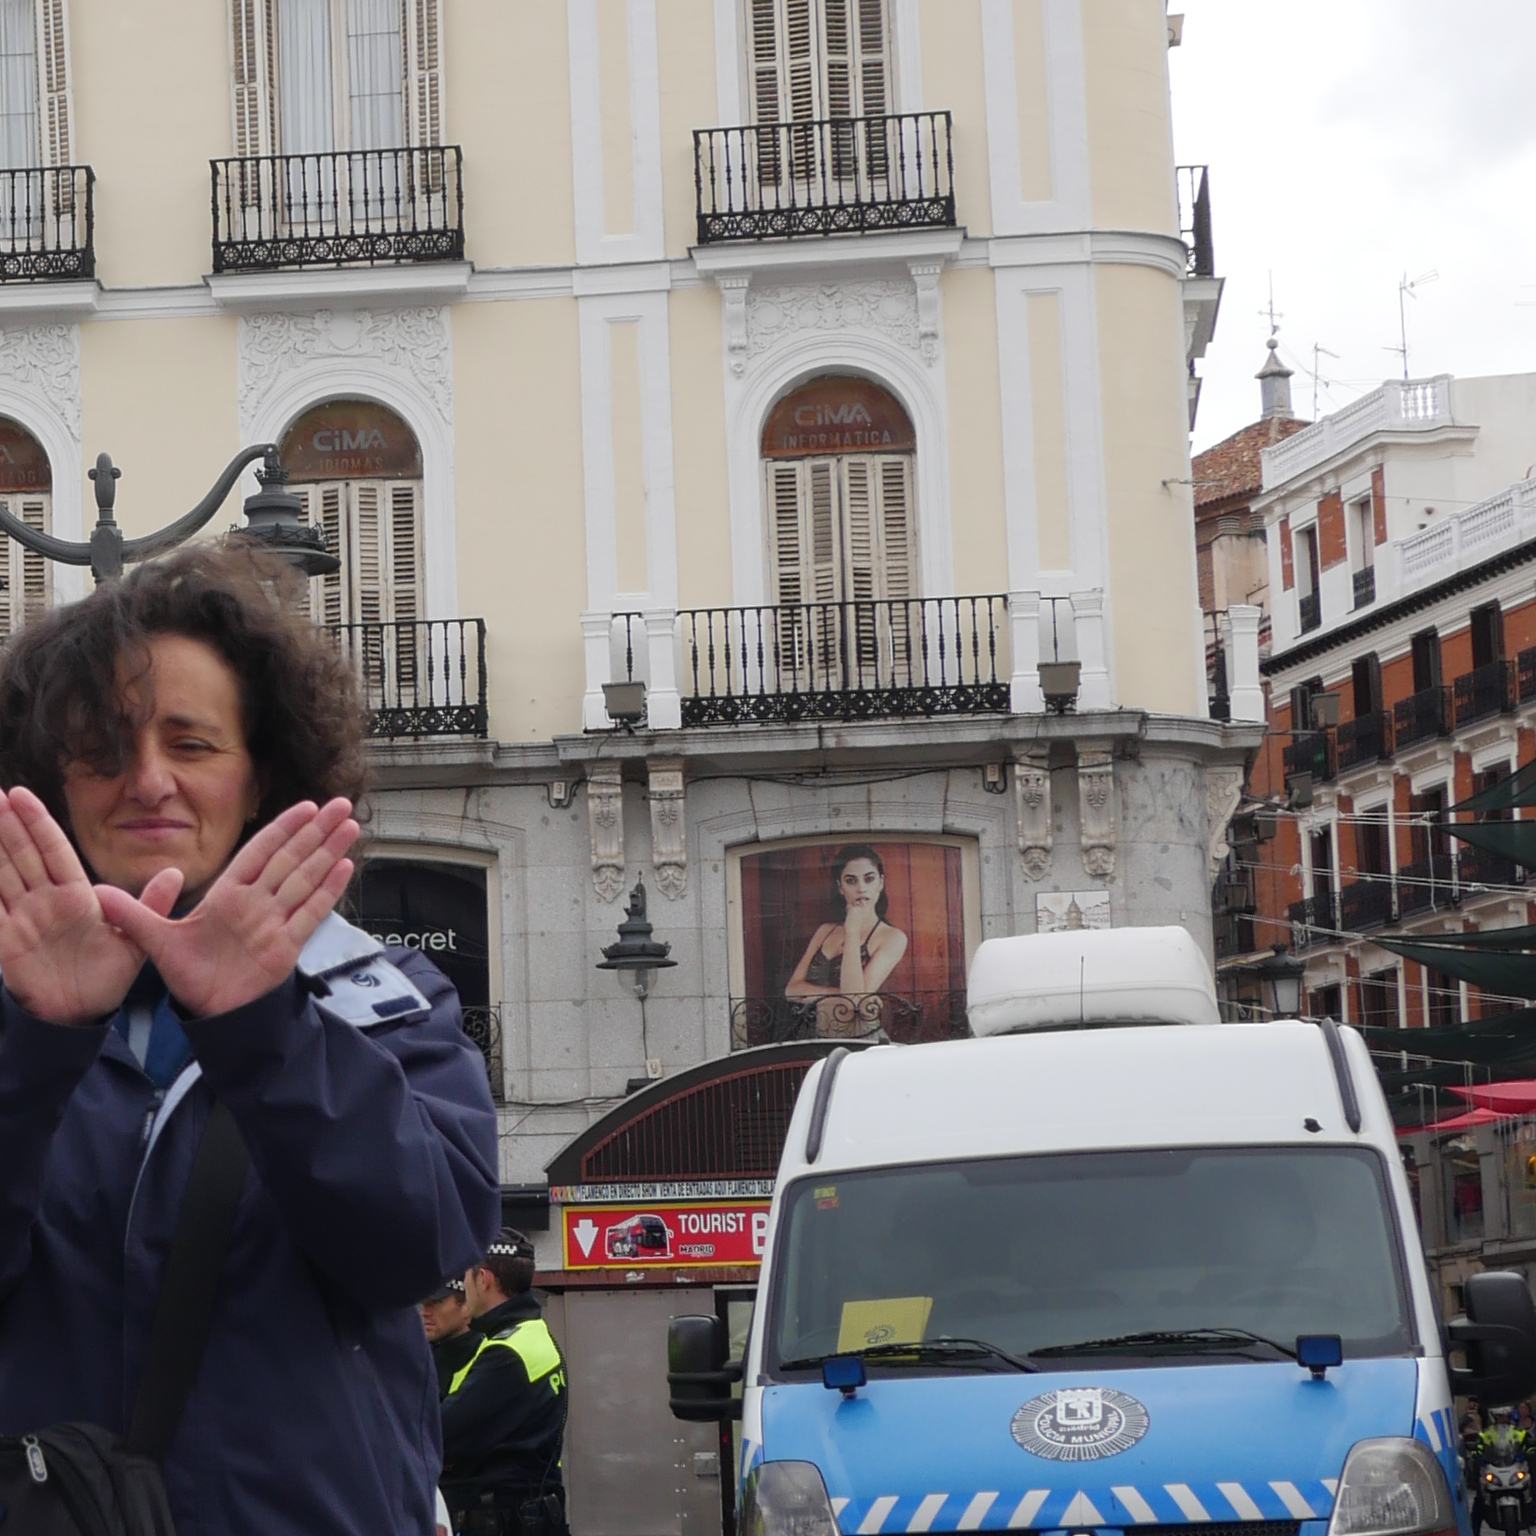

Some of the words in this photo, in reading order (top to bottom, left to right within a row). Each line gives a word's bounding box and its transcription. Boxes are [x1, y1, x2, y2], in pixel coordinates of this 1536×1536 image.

[783, 430, 892, 449] INFORMATICA
[319, 457, 384, 472] IDIOMAS
[678, 1212, 746, 1234] TOURIST
[679, 1243, 715, 1255] MADRID
[1071, 1410, 1122, 1444] MUNICIPAL
